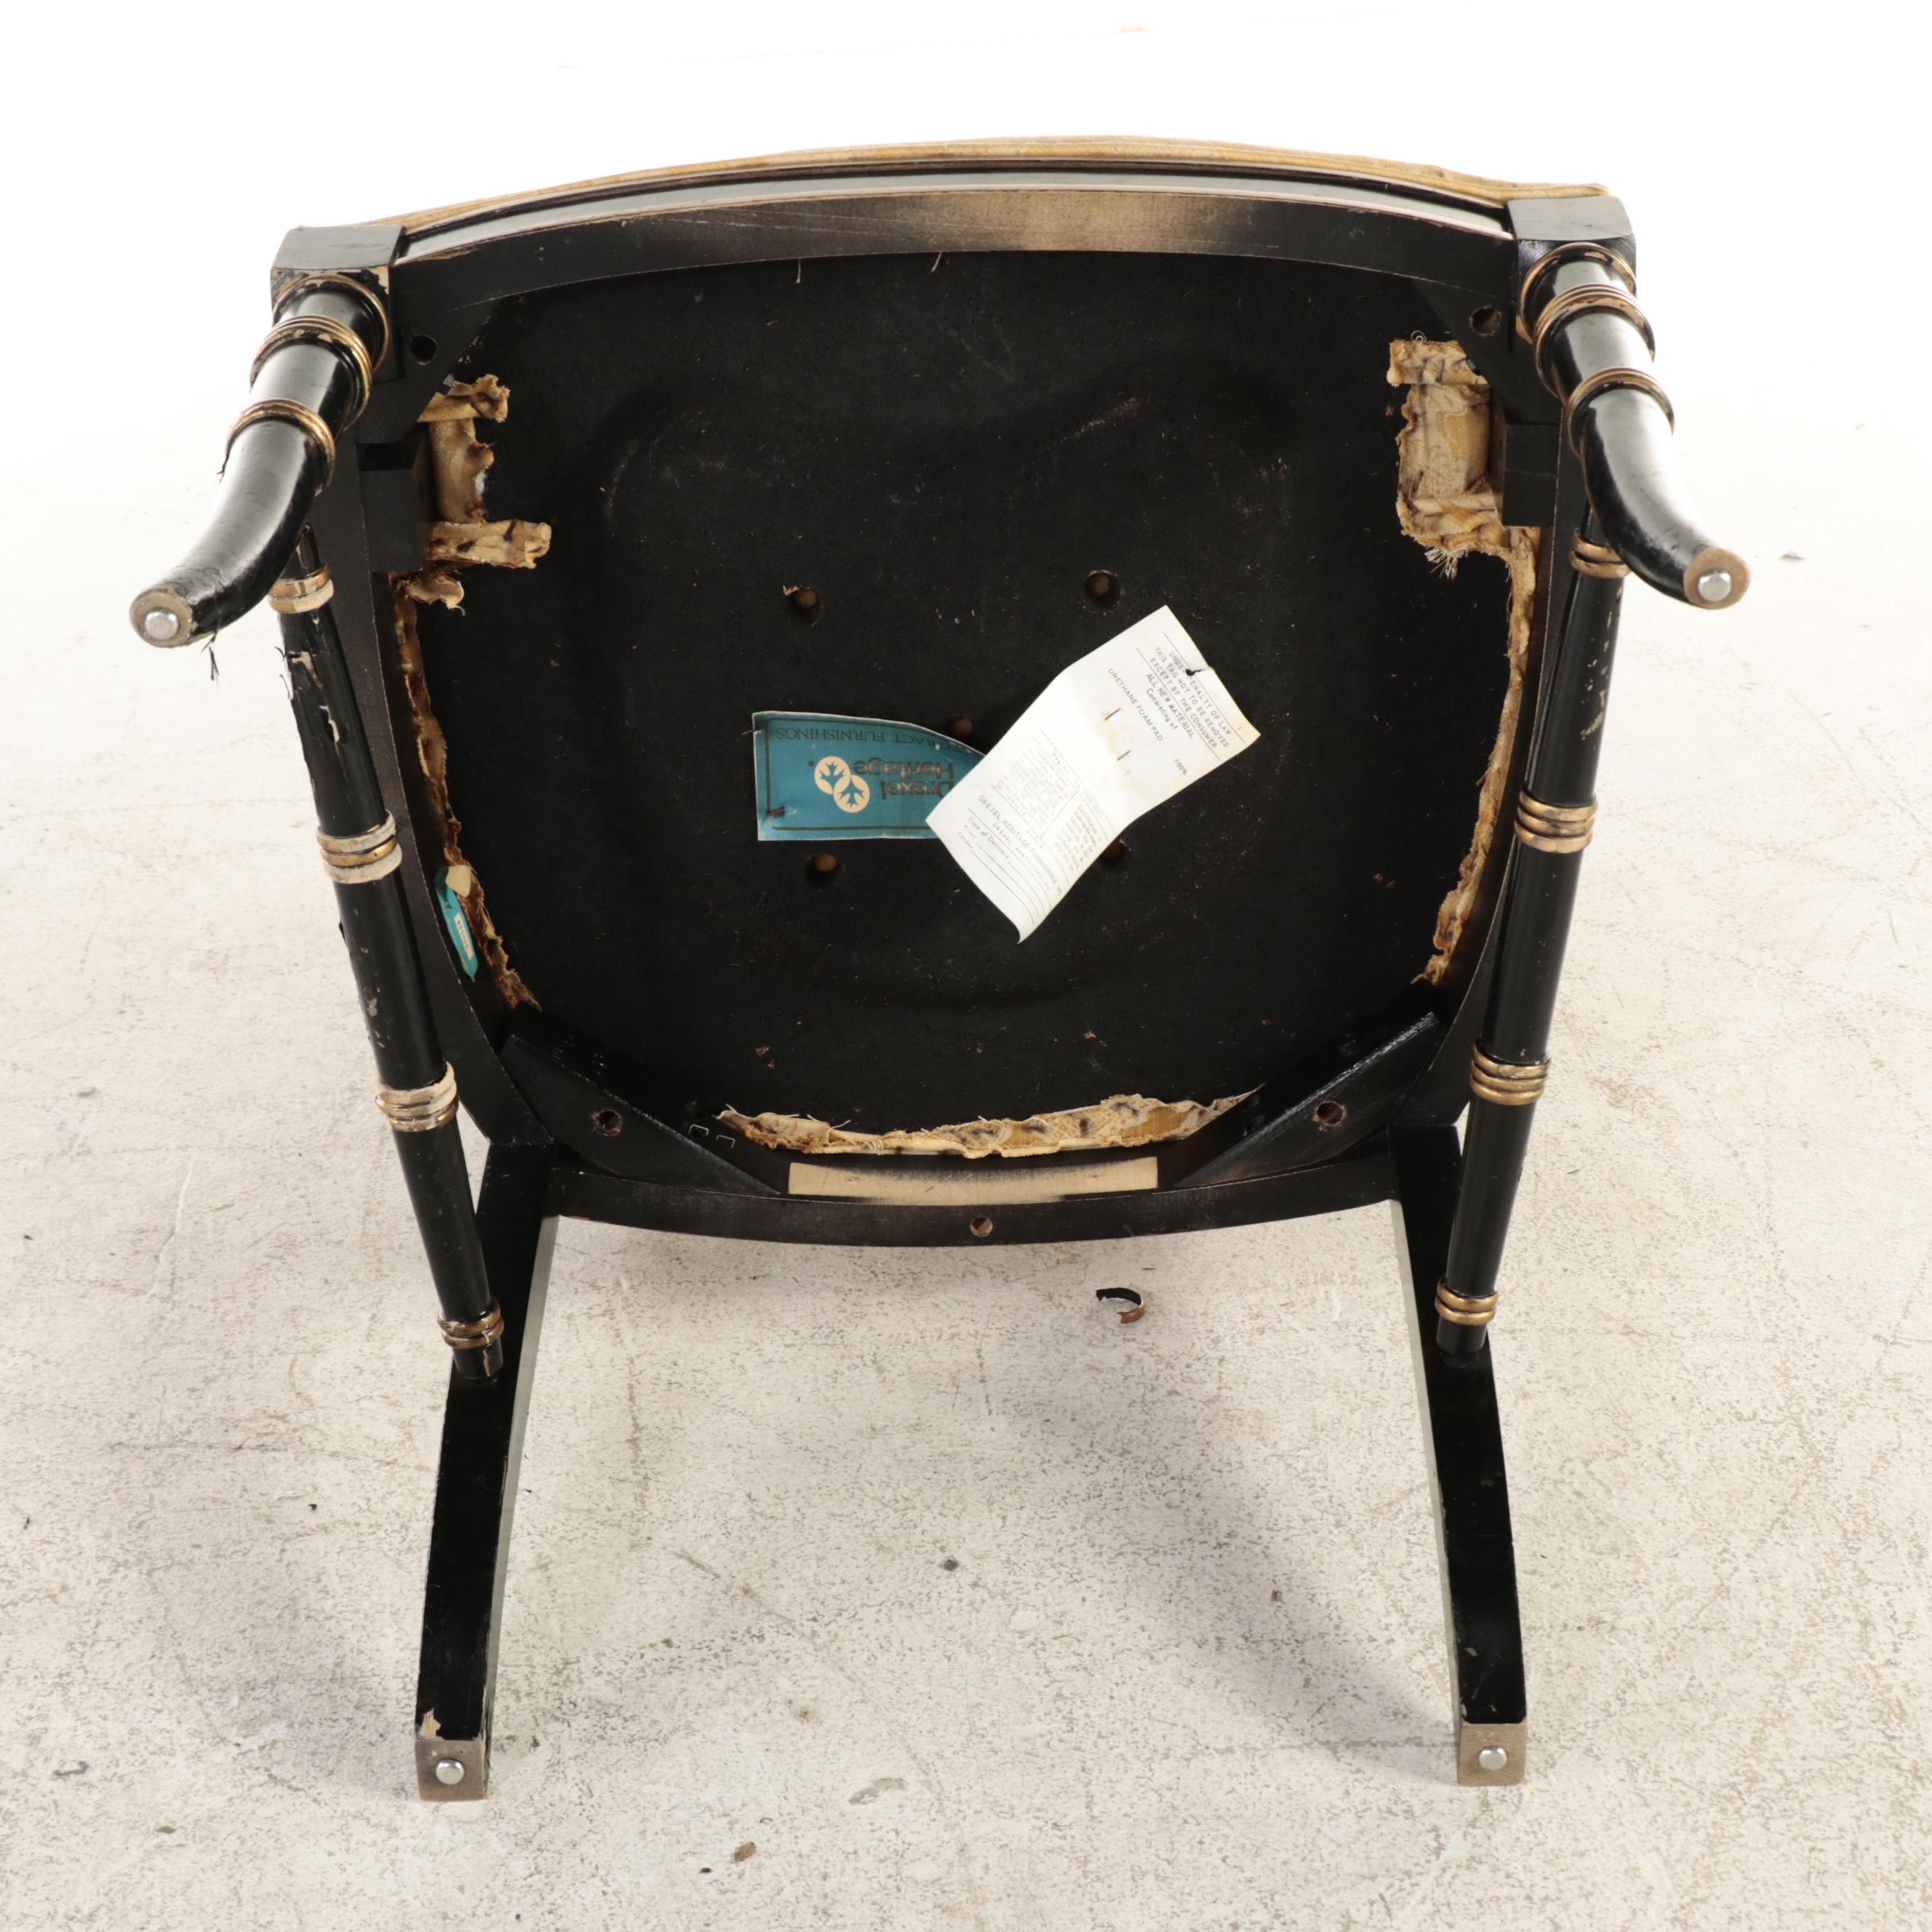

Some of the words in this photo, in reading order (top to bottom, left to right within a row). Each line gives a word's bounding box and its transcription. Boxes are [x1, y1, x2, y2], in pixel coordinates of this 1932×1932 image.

[1107, 666, 1138, 706] URETHANE
[1134, 704, 1154, 727] FOAM
[1149, 724, 1164, 742] PAD
[1173, 757, 1189, 775] 100%
[1143, 687, 1173, 722] Consisting
[1169, 720, 1179, 730] of
[1145, 671, 1159, 687] ALL
[1156, 687, 1171, 703] NEW
[1167, 702, 1197, 739] MATERIAL
[1149, 656, 1173, 685] EXCEPT
[1170, 685, 1181, 696] BY
[1178, 697, 1192, 712] THE
[1189, 711, 1218, 749] CONSUMER
[1152, 645, 1167, 663] THIS
[1165, 663, 1179, 679] TAG
[1176, 678, 1190, 694] NOT
[1188, 694, 1199, 706] TO
[1196, 705, 1207, 716] BE
[1203, 716, 1230, 749] REMOVED
[1167, 650, 1187, 674] UNDE
[1210, 709, 1220, 720] OF
[1218, 720, 1232, 736] LAW
[775, 727, 885, 743] FURNISHINGS
[853, 757, 954, 780] Heritage
[880, 780, 954, 800] Drexel
[967, 815, 982, 831] Date
[980, 829, 989, 837] of
[986, 834, 1010, 861] Delivery
[977, 793, 1003, 822] DREXEL
[1001, 817, 1031, 850] HERITAGE
